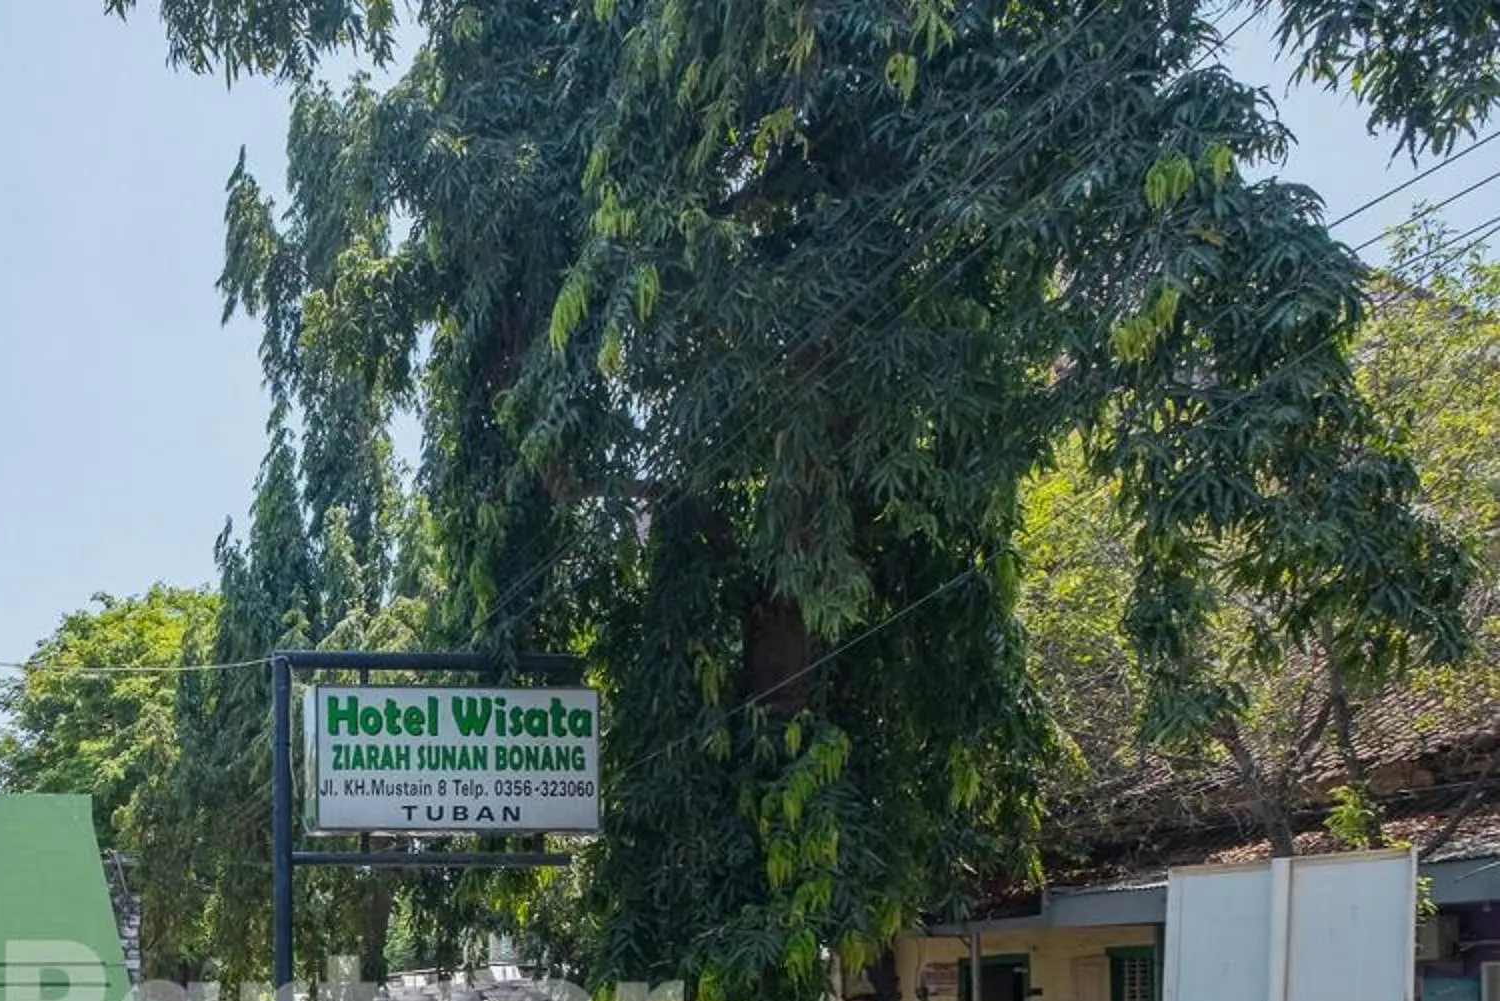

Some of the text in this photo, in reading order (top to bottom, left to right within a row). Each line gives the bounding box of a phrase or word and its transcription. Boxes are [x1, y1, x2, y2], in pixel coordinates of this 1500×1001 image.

[327, 695, 593, 738] Hotel Wisata
[332, 744, 587, 772] ZIARAH SUNAN BONANG
[320, 779, 338, 797] Jl.
[437, 779, 447, 797] 8
[452, 779, 489, 800] Telp.
[401, 805, 522, 822] TUBAN
